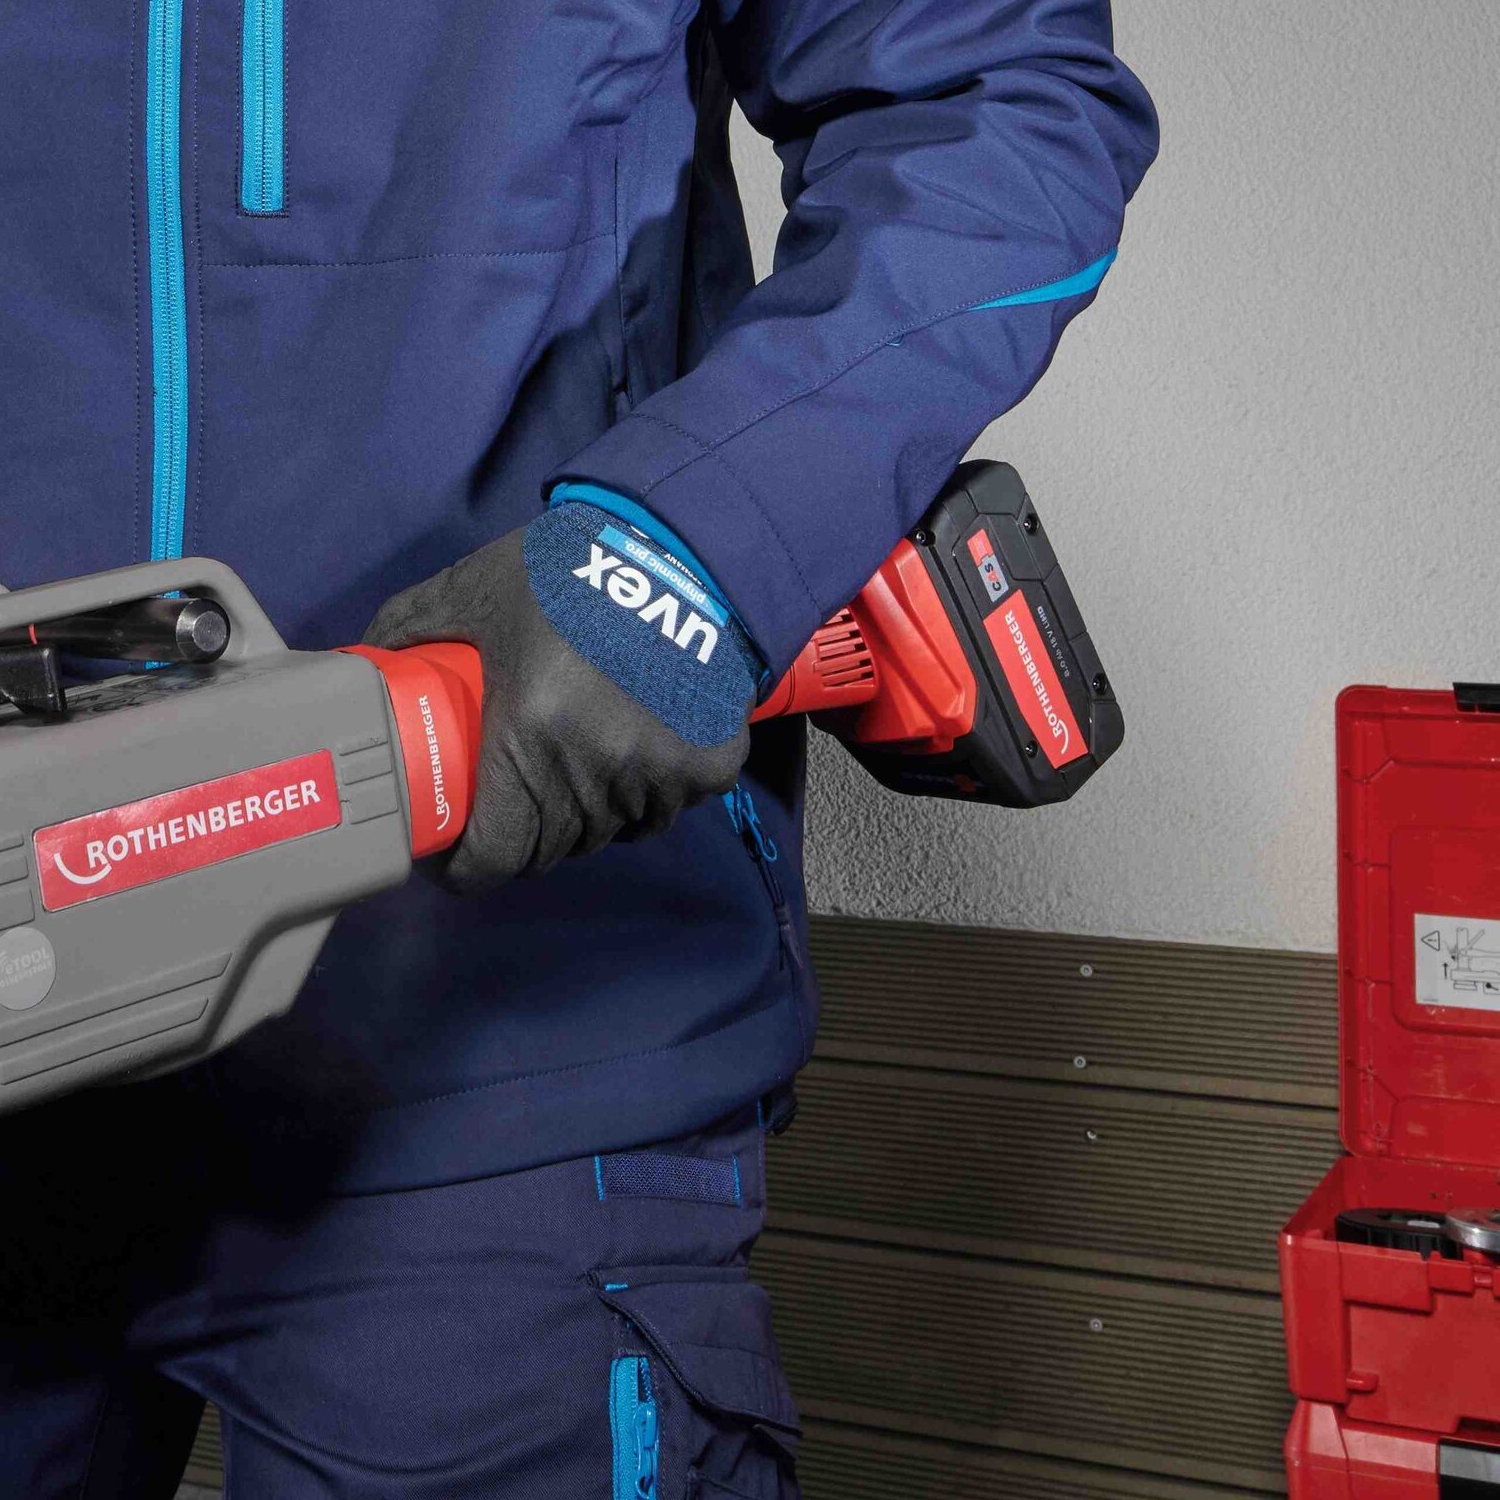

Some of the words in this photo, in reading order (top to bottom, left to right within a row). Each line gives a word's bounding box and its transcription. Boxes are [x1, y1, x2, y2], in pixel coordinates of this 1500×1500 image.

[572, 543, 719, 664] uvex
[647, 556, 707, 604] phynomic
[1004, 609, 1066, 742] ROTHENBERGER
[418, 695, 449, 822] ROTHENBERGER
[84, 778, 322, 870] ROTHENBERGER
